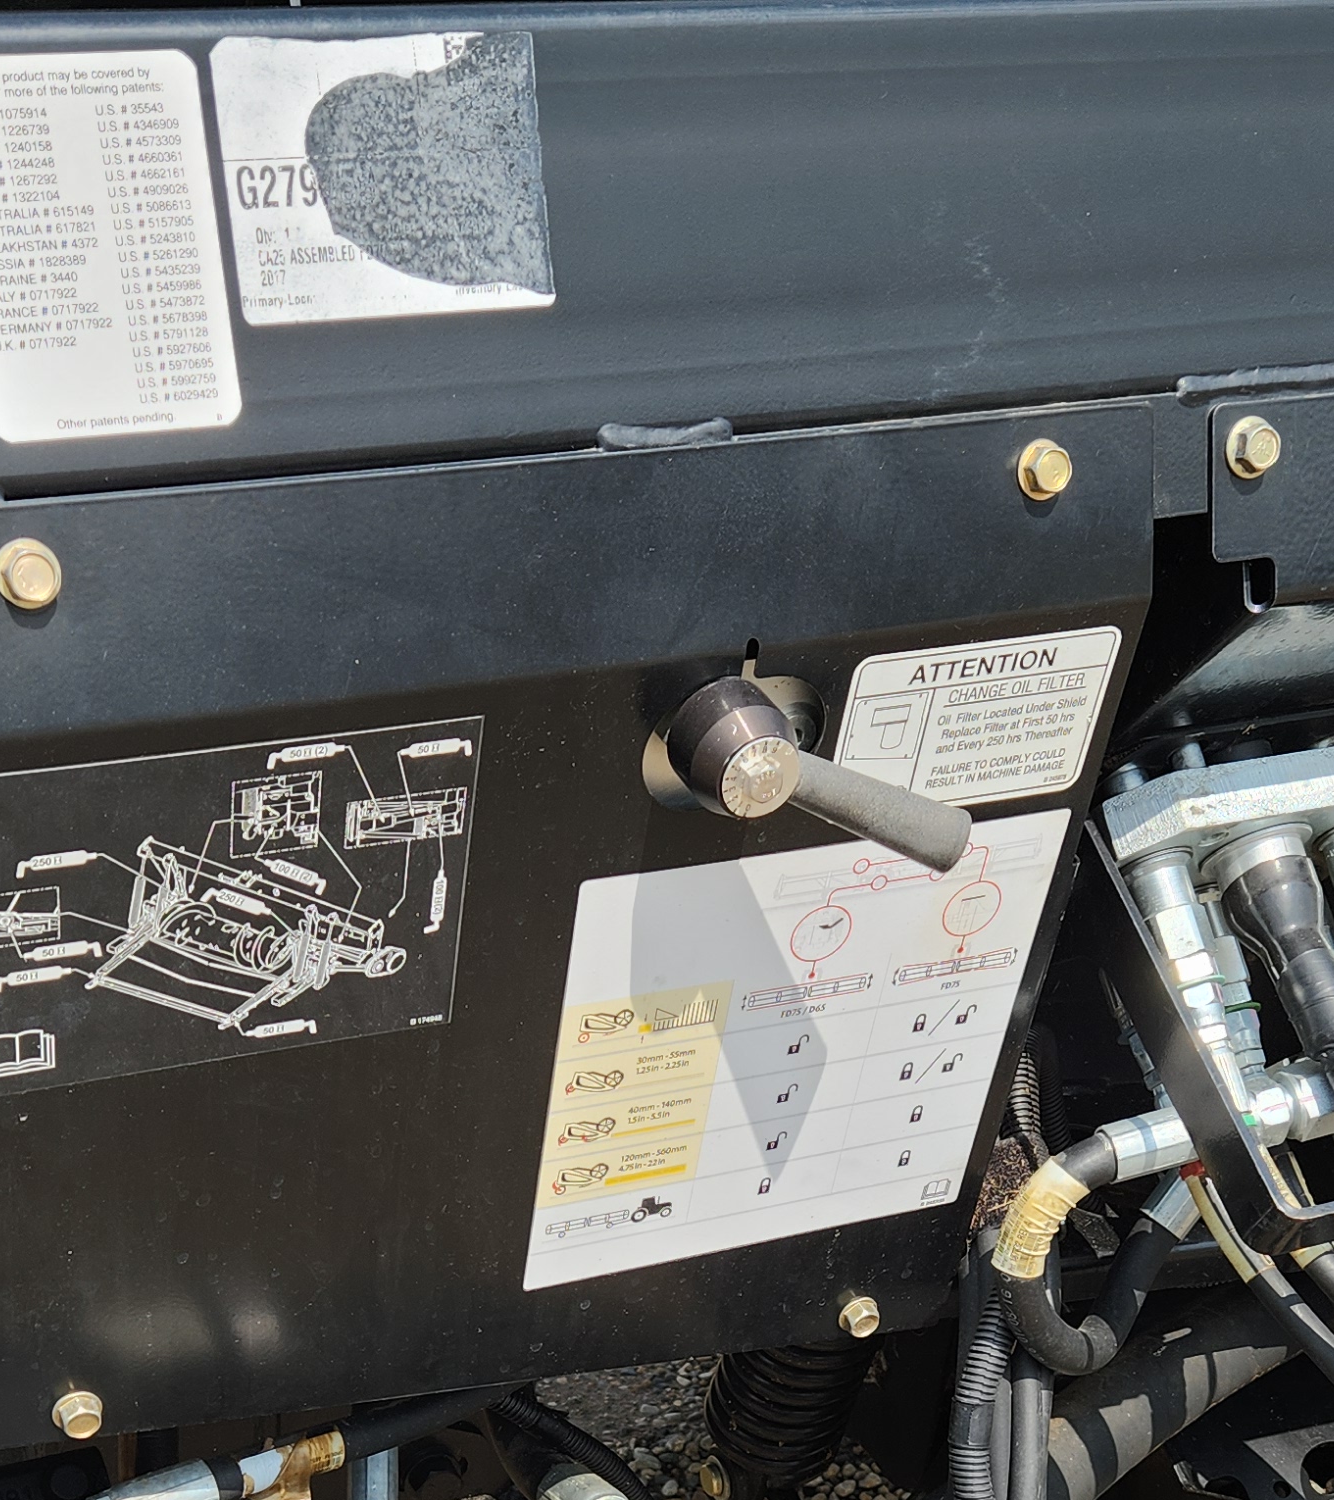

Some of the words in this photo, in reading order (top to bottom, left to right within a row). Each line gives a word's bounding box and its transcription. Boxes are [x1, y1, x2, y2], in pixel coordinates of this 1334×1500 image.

[1, 70, 44, 84] product
[47, 71, 70, 83] may
[73, 68, 88, 80] be
[90, 67, 134, 79] covered
[136, 66, 149, 79] by
[3, 87, 33, 97] more
[35, 84, 46, 96] of
[49, 84, 67, 96] the
[70, 83, 118, 96] following
[121, 82, 163, 95] patents:
[94, 103, 118, 116] U.S.
[120, 104, 127, 115] #
[130, 102, 163, 114] 35543
[1, 123, 50, 136] 1226739
[97, 119, 120, 132] U.S.
[123, 120, 129, 131] #
[133, 117, 179, 131] 4346909
[4, 140, 52, 152] 1240158
[99, 136, 122, 149] U.S.
[125, 137, 132, 147] #
[135, 134, 181, 146] 4573309
[42, 207, 49, 217] #
[52, 204, 94, 217] 615149
[60, 239, 67, 249] #
[71, 236, 98, 248] 4372
[28, 257, 35, 267] #
[39, 254, 86, 267] 1828389
[289, 246, 355, 265] ASSEMBLED
[40, 273, 47, 283] #
[49, 270, 78, 283] 3440
[56, 418, 86, 429] Other
[89, 415, 129, 429] patents
[132, 412, 173, 425] pending.
[907, 646, 1058, 686] ATTENTION
[947, 681, 1008, 703] CHANGE
[1010, 679, 1033, 694] OIL
[1036, 672, 1085, 691] FILTER
[937, 714, 951, 726] Oil
[955, 711, 982, 724] Filter
[982, 703, 1024, 720] Located
[1025, 700, 1056, 713] Under
[1056, 695, 1087, 709] Shield
[940, 726, 981, 740] Replace
[982, 722, 1009, 733] Filter
[1009, 718, 1020, 730] at
[1021, 715, 1044, 728] First
[1045, 713, 1058, 724] 50
[1058, 712, 1075, 723] hrs
[935, 741, 955, 754] and
[956, 739, 985, 751] Every
[985, 734, 1004, 747] 250
[1005, 733, 1021, 744] hrs
[1024, 726, 1073, 741] Thereafter
[930, 760, 972, 776] FAILURE
[974, 758, 987, 770] TO
[989, 752, 1032, 768] COMPLY
[1032, 747, 1065, 761] COULD
[924, 774, 964, 789] RESULT
[964, 772, 975, 783] IN
[976, 765, 1022, 782] MACHINE
[1022, 758, 1065, 775] DAMAGE
[33, 856, 52, 867] 250
[42, 947, 54, 957] 50
[16, 972, 28, 982] 50
[940, 980, 961, 990] FD75
[636, 1053, 664, 1065] 30mm
[628, 1104, 655, 1115] 40mm
[661, 1097, 692, 1109] 140mm
[620, 1150, 651, 1162] 120mm
